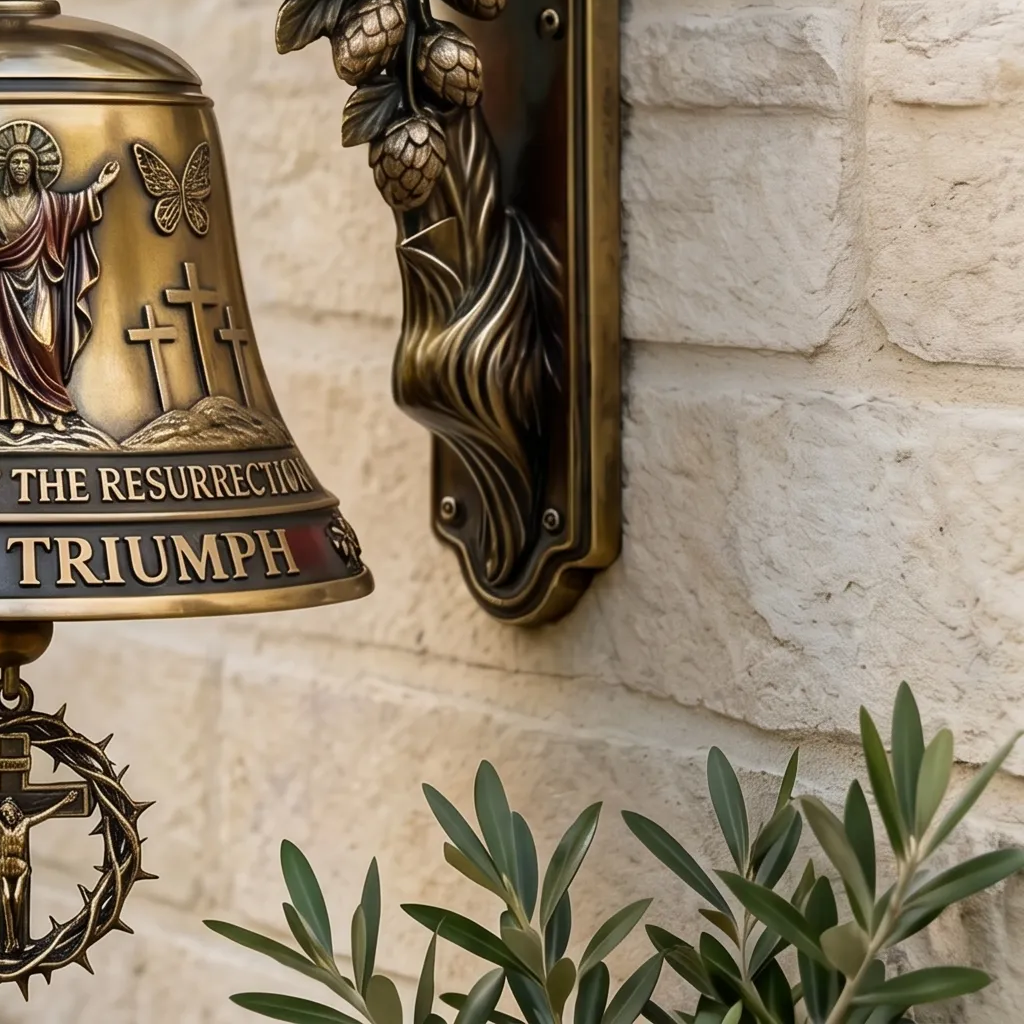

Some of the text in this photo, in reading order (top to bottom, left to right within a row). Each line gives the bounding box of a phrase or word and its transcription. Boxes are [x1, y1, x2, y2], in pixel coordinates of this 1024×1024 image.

[11, 468, 90, 503] THE
[98, 457, 314, 502] RESURRECTION
[6, 528, 301, 585] TRIUMPH
